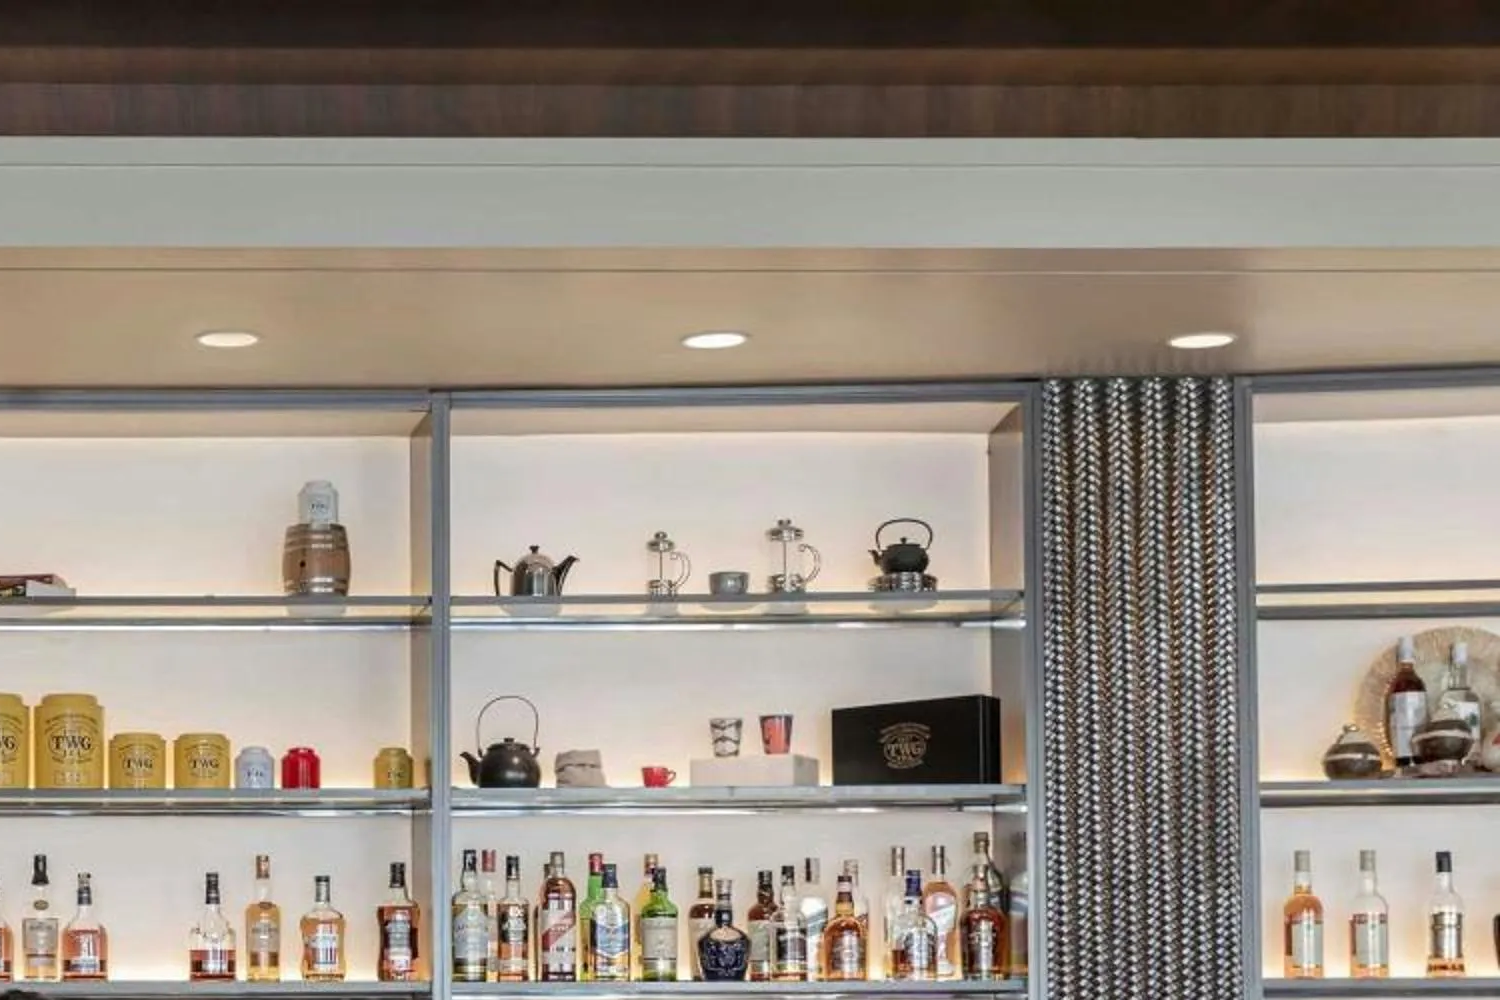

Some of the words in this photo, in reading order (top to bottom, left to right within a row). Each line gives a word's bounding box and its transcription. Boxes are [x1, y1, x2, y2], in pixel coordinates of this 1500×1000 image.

[52, 736, 92, 750] TWG
[887, 742, 924, 757] TWG
[125, 758, 154, 770] TWG
[191, 758, 220, 770] TWG
